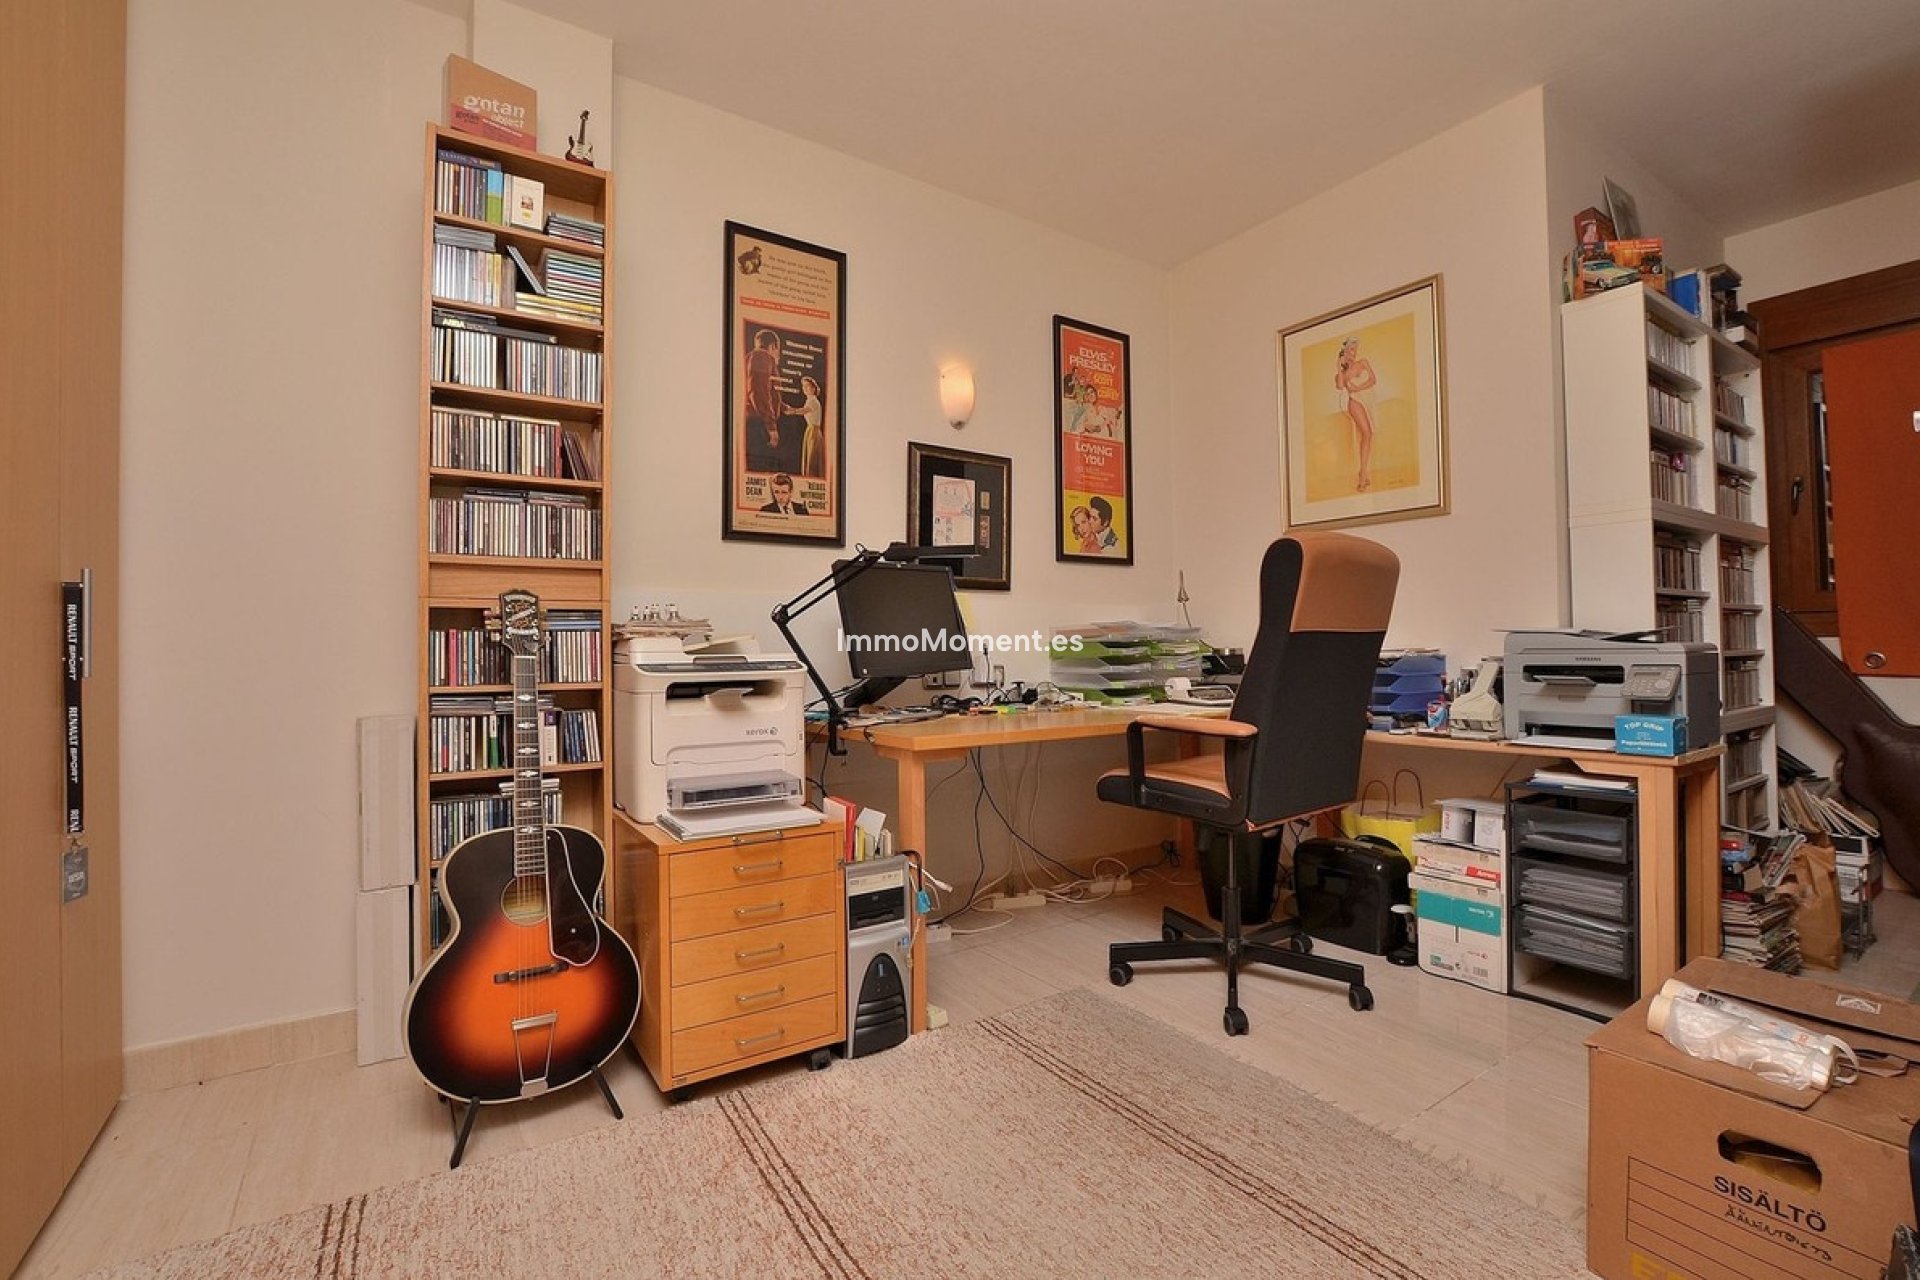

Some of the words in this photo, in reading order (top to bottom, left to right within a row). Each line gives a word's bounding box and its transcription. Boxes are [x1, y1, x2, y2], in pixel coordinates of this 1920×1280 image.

[1069, 354, 1116, 374] PRESLEY
[1079, 347, 1107, 362] ELVIS
[1074, 440, 1113, 458] LOVING
[1083, 454, 1105, 467] YOU
[745, 476, 767, 487] JAMES
[745, 486, 763, 496] DEAN
[67, 604, 78, 644] RENAULT
[68, 644, 77, 681] SPORT
[68, 706, 79, 746] RENAULT
[1714, 1175, 1827, 1233] SISÄLTÖ
